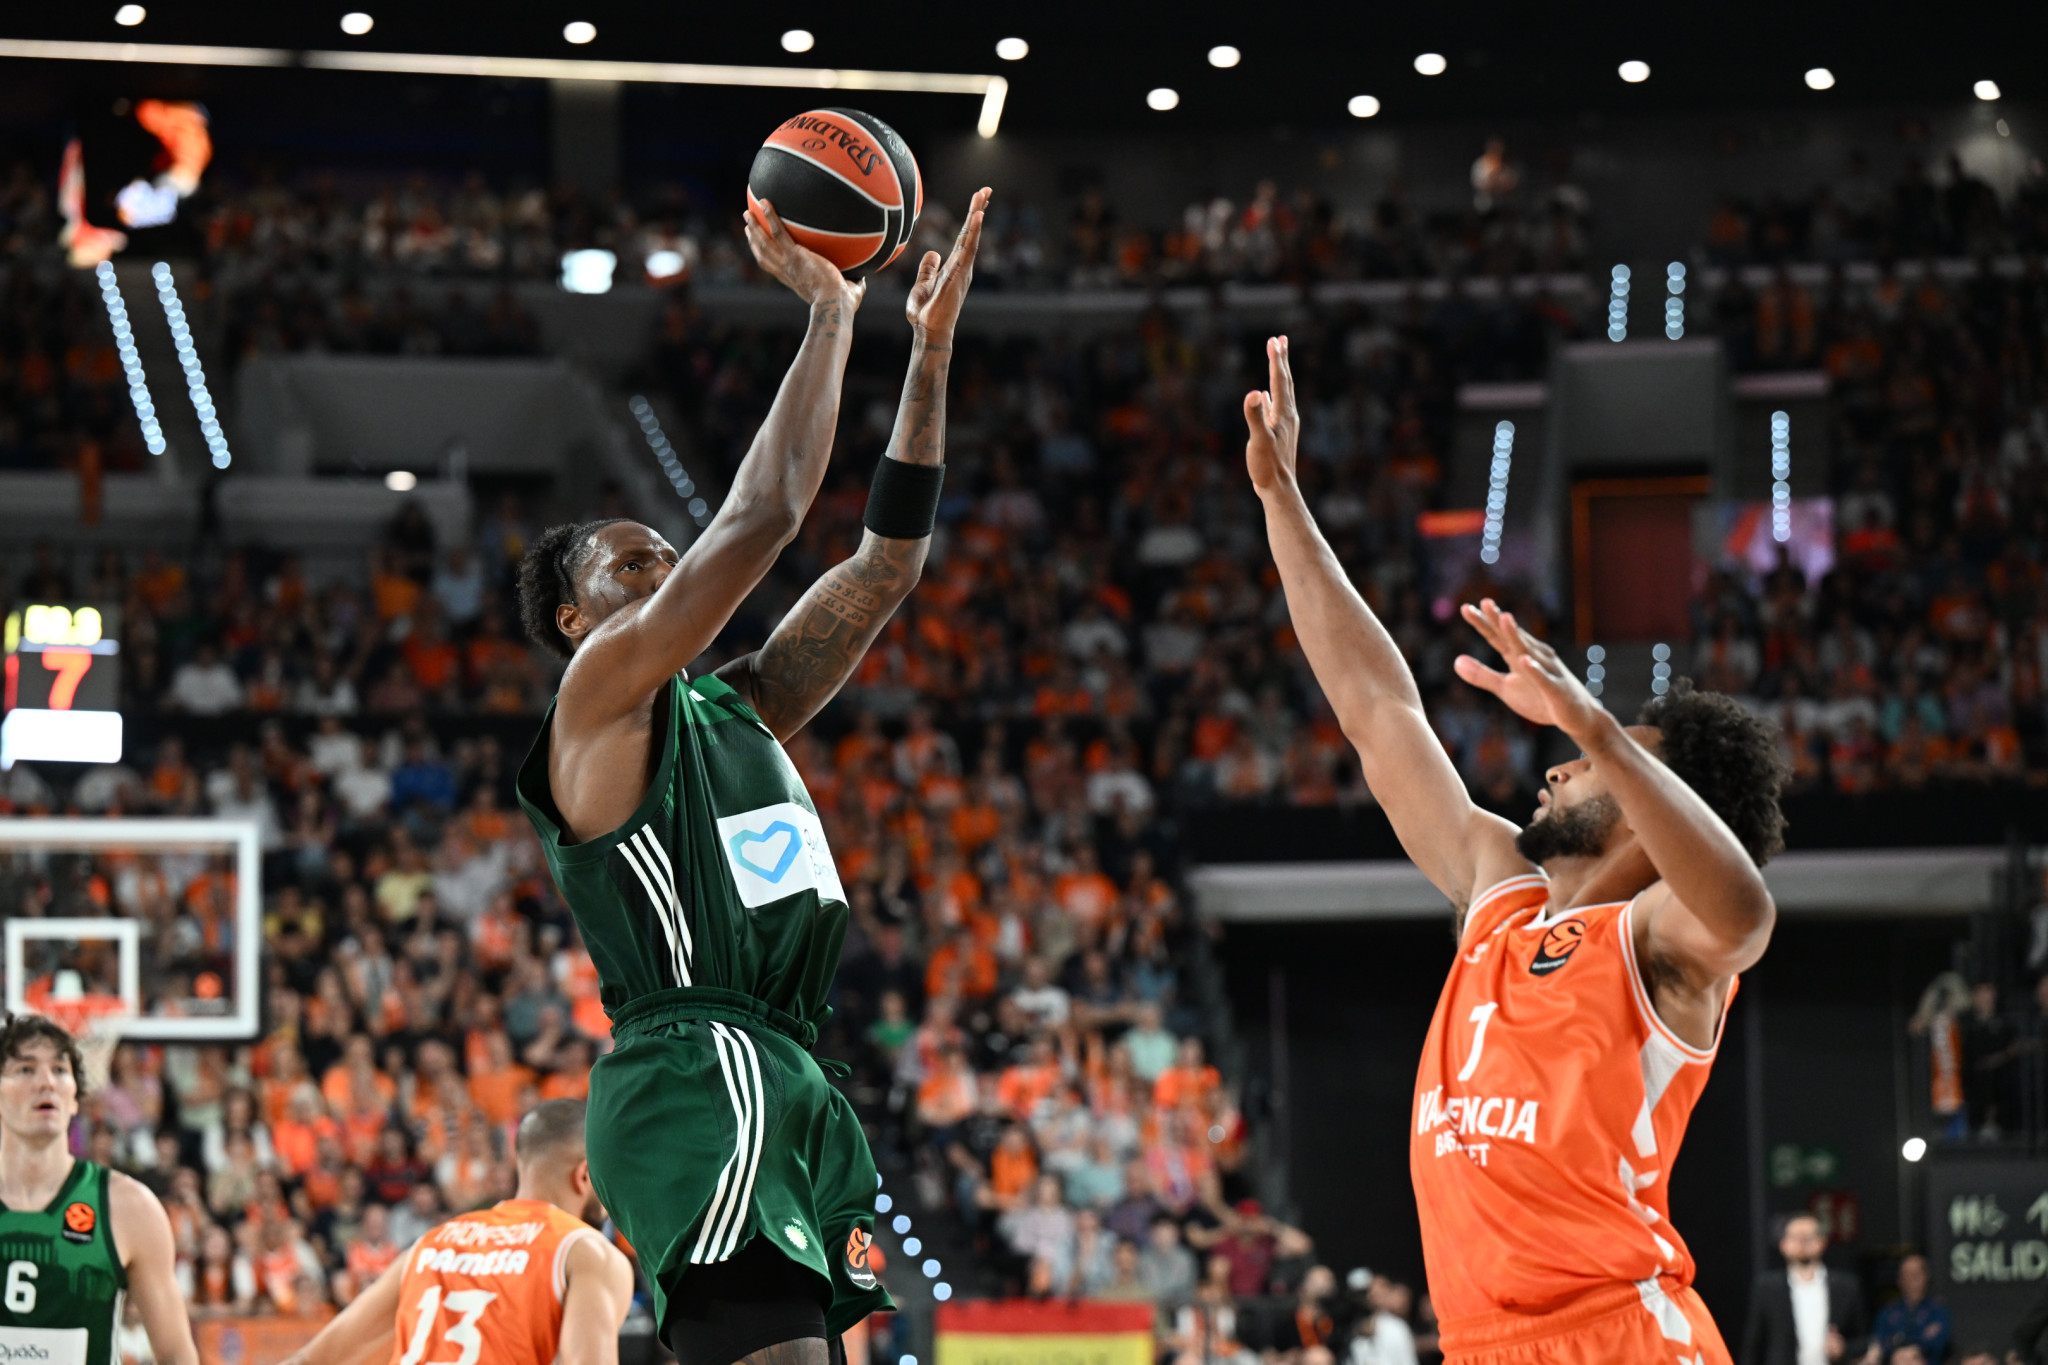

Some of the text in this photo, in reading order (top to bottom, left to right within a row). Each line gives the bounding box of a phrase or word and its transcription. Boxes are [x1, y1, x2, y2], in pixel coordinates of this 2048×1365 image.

[780, 115, 885, 177] SPALDING
[41, 646, 93, 711] 7
[1417, 1084, 1539, 1145] VALENCIA
[435, 1221, 545, 1246] THOMPSON
[4, 1259, 39, 1314] 6
[401, 1285, 498, 1365] 13
